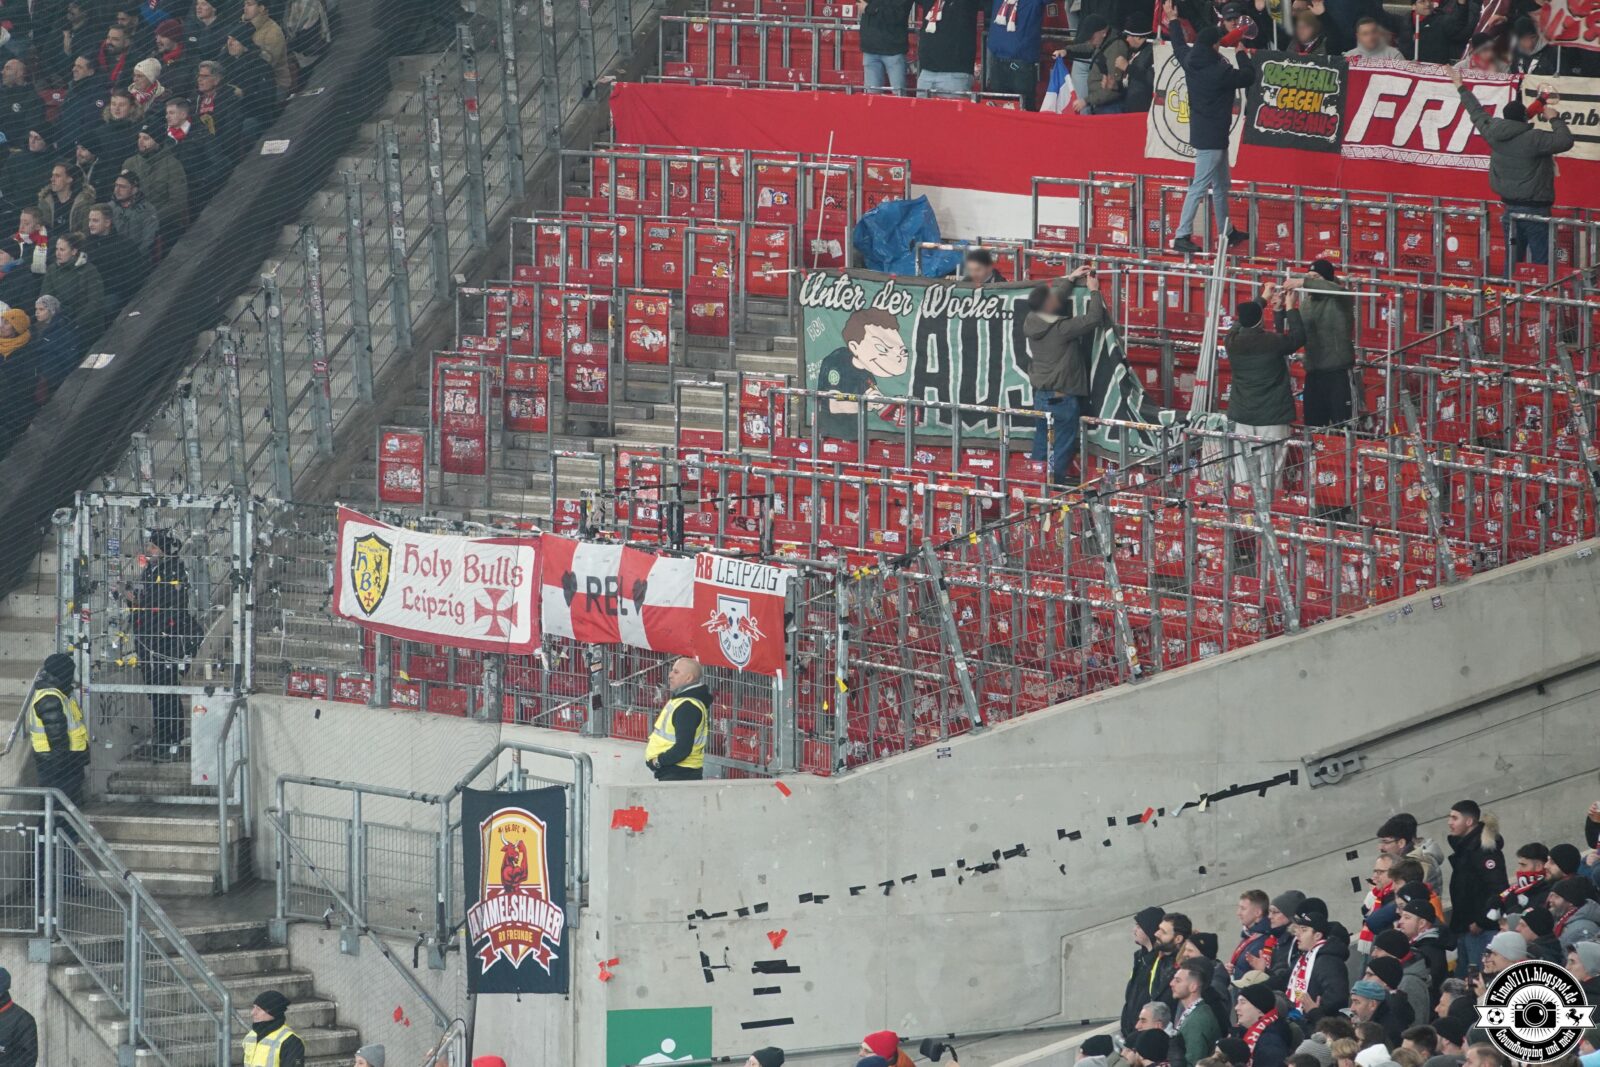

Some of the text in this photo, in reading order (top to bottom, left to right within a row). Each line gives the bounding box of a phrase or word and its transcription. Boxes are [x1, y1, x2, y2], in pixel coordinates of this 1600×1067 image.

[1277, 87, 1323, 113] GEGEN
[799, 271, 867, 312] Unter
[871, 279, 914, 317] der
[403, 543, 523, 588] Holy Bulls
[695, 553, 781, 591] RB LEIPZIG
[402, 586, 465, 625] Leipzig
[469, 895, 561, 940] AMMELSHAINER
